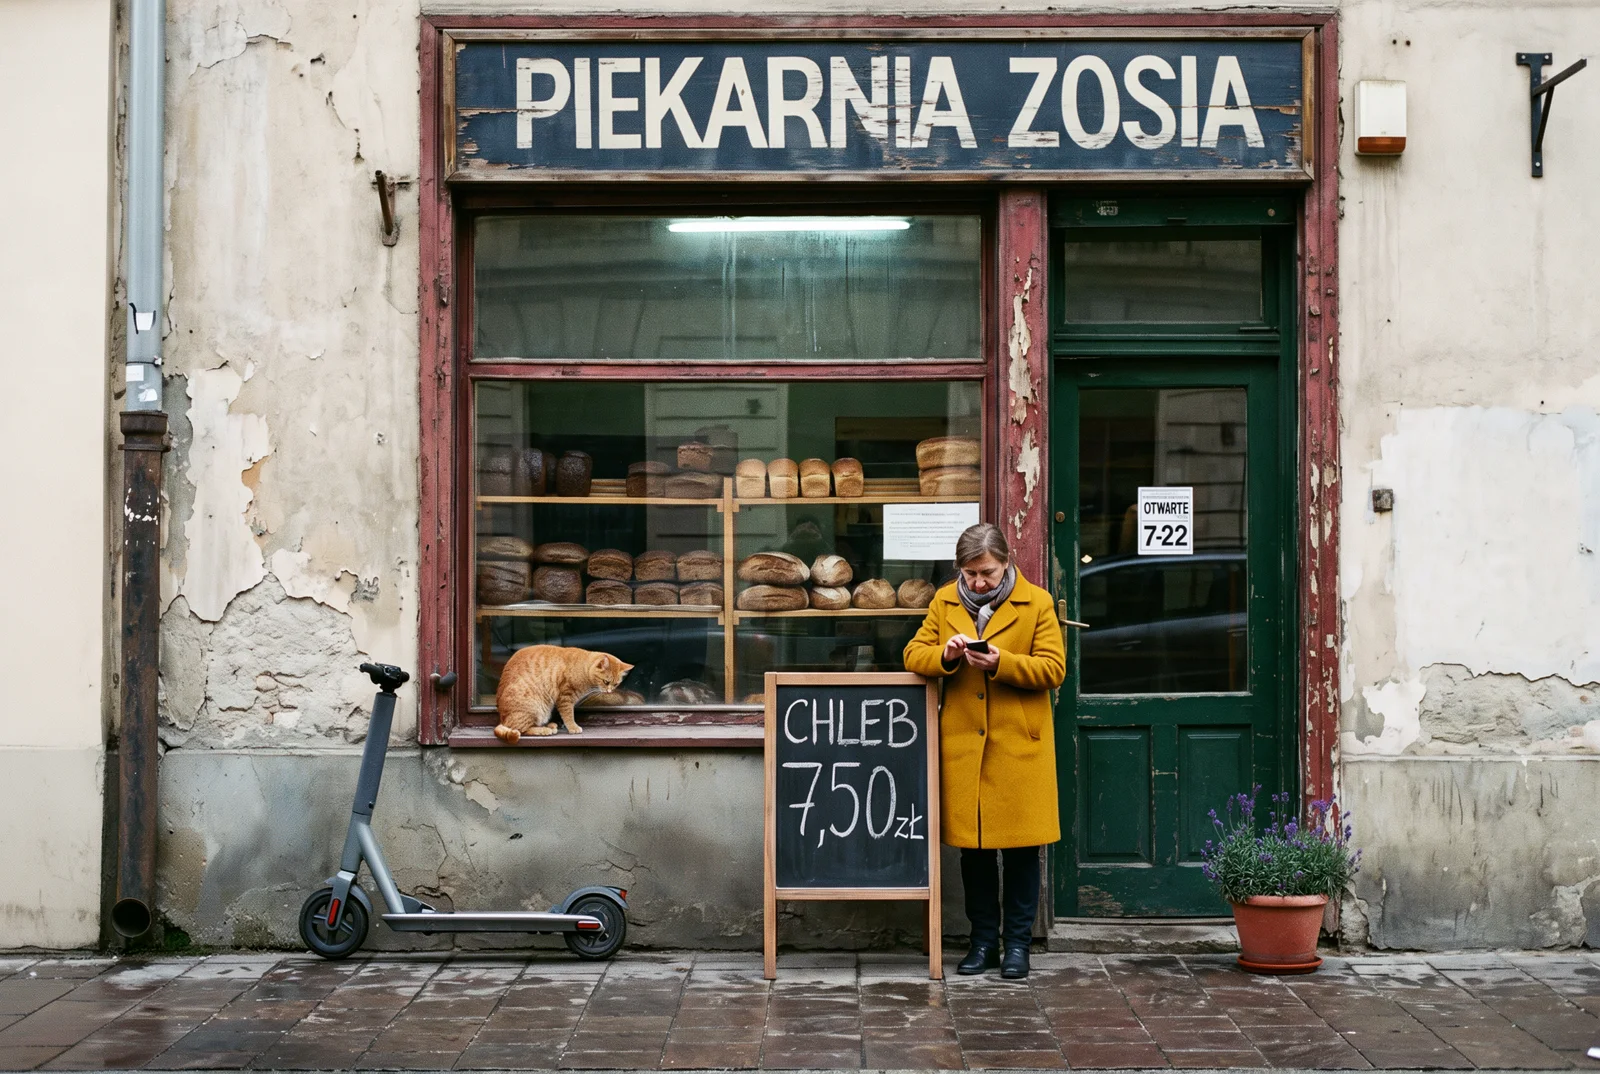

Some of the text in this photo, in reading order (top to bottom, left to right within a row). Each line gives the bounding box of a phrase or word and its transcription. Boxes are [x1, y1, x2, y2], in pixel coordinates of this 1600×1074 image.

[516, 54, 1266, 150] PIEKARNIA ZOSIA
[1143, 501, 1189, 515] OTWARTE
[1143, 524, 1188, 547] 7-22
[783, 698, 919, 748] CHLEB
